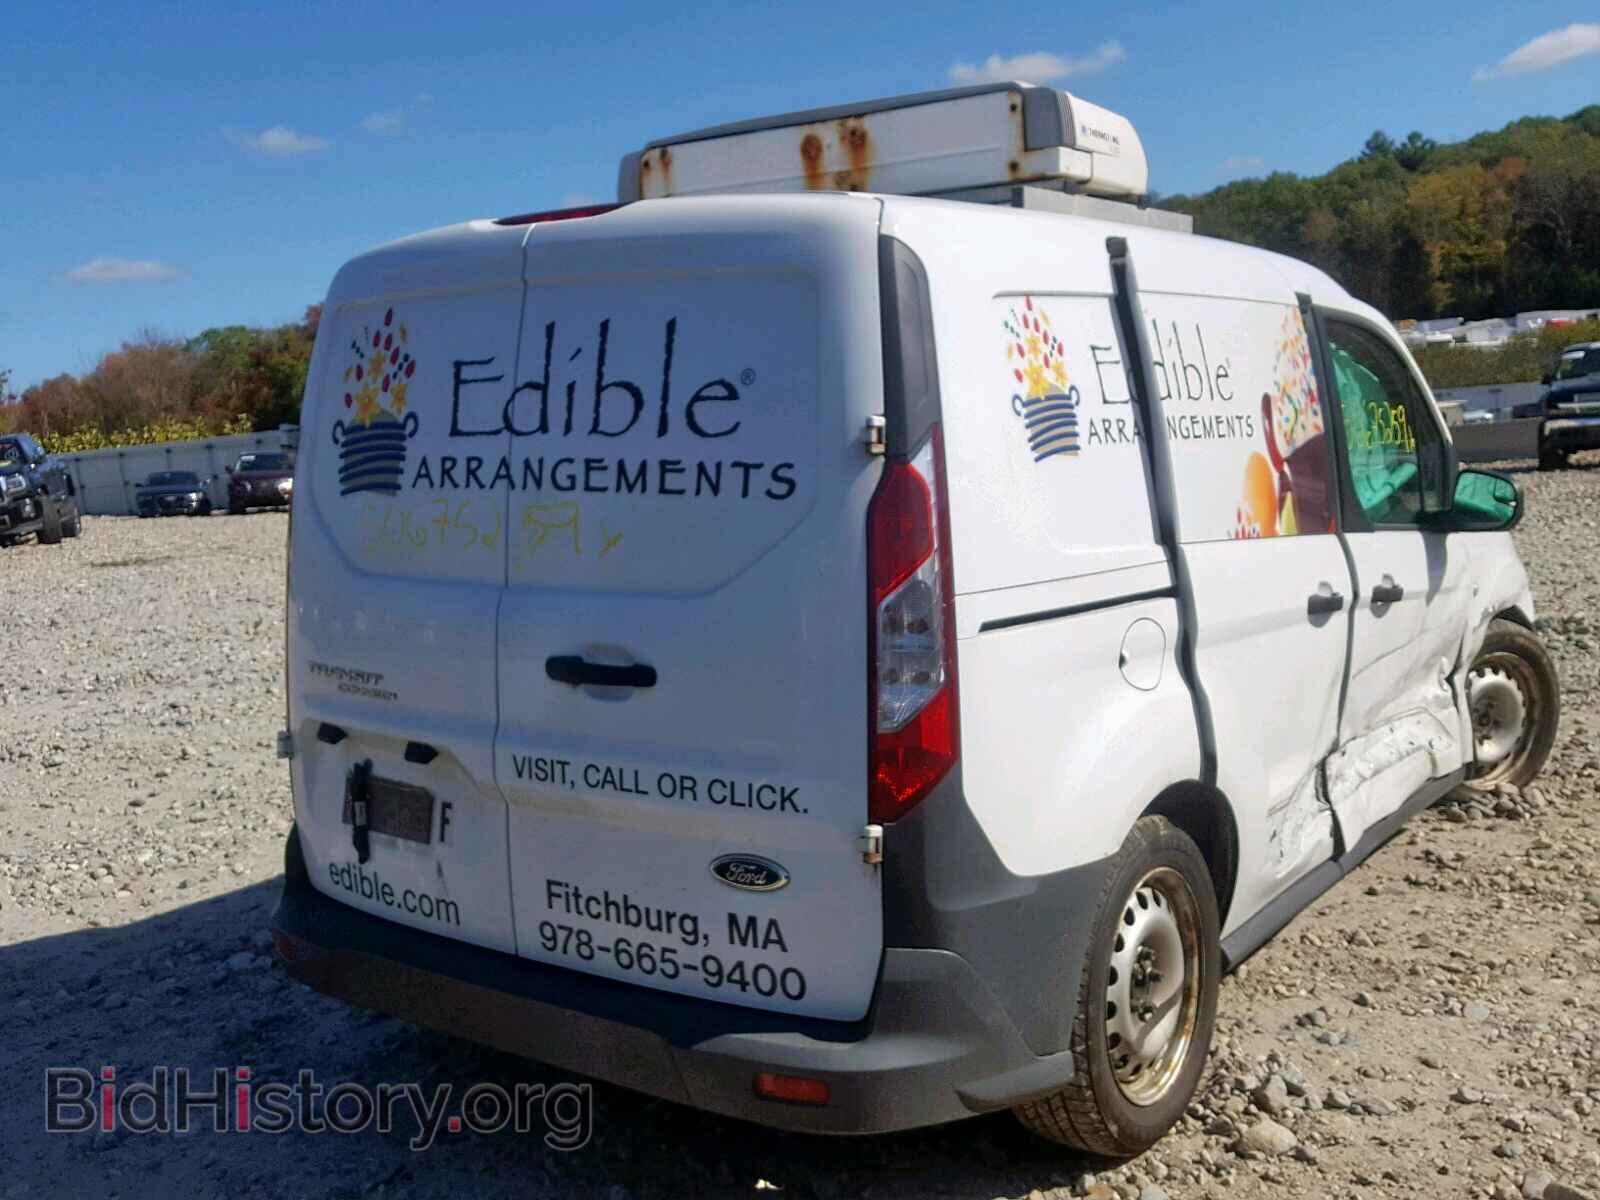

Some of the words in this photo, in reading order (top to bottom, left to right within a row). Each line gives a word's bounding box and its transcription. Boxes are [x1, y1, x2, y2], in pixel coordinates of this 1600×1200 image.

[449, 316, 741, 438] Edible
[1088, 319, 1234, 404] Edible
[412, 455, 798, 501] ARRANGEMENTS
[512, 754, 576, 789] VISIT,
[583, 763, 649, 796] CALL
[657, 772, 698, 801] OR
[707, 778, 809, 814] CLICK.
[328, 862, 461, 927] edible.com
[725, 862, 769, 885] Ford
[546, 878, 710, 948] Fitchburg,
[728, 912, 789, 953] MA
[539, 921, 807, 1001] 978-665-9400
